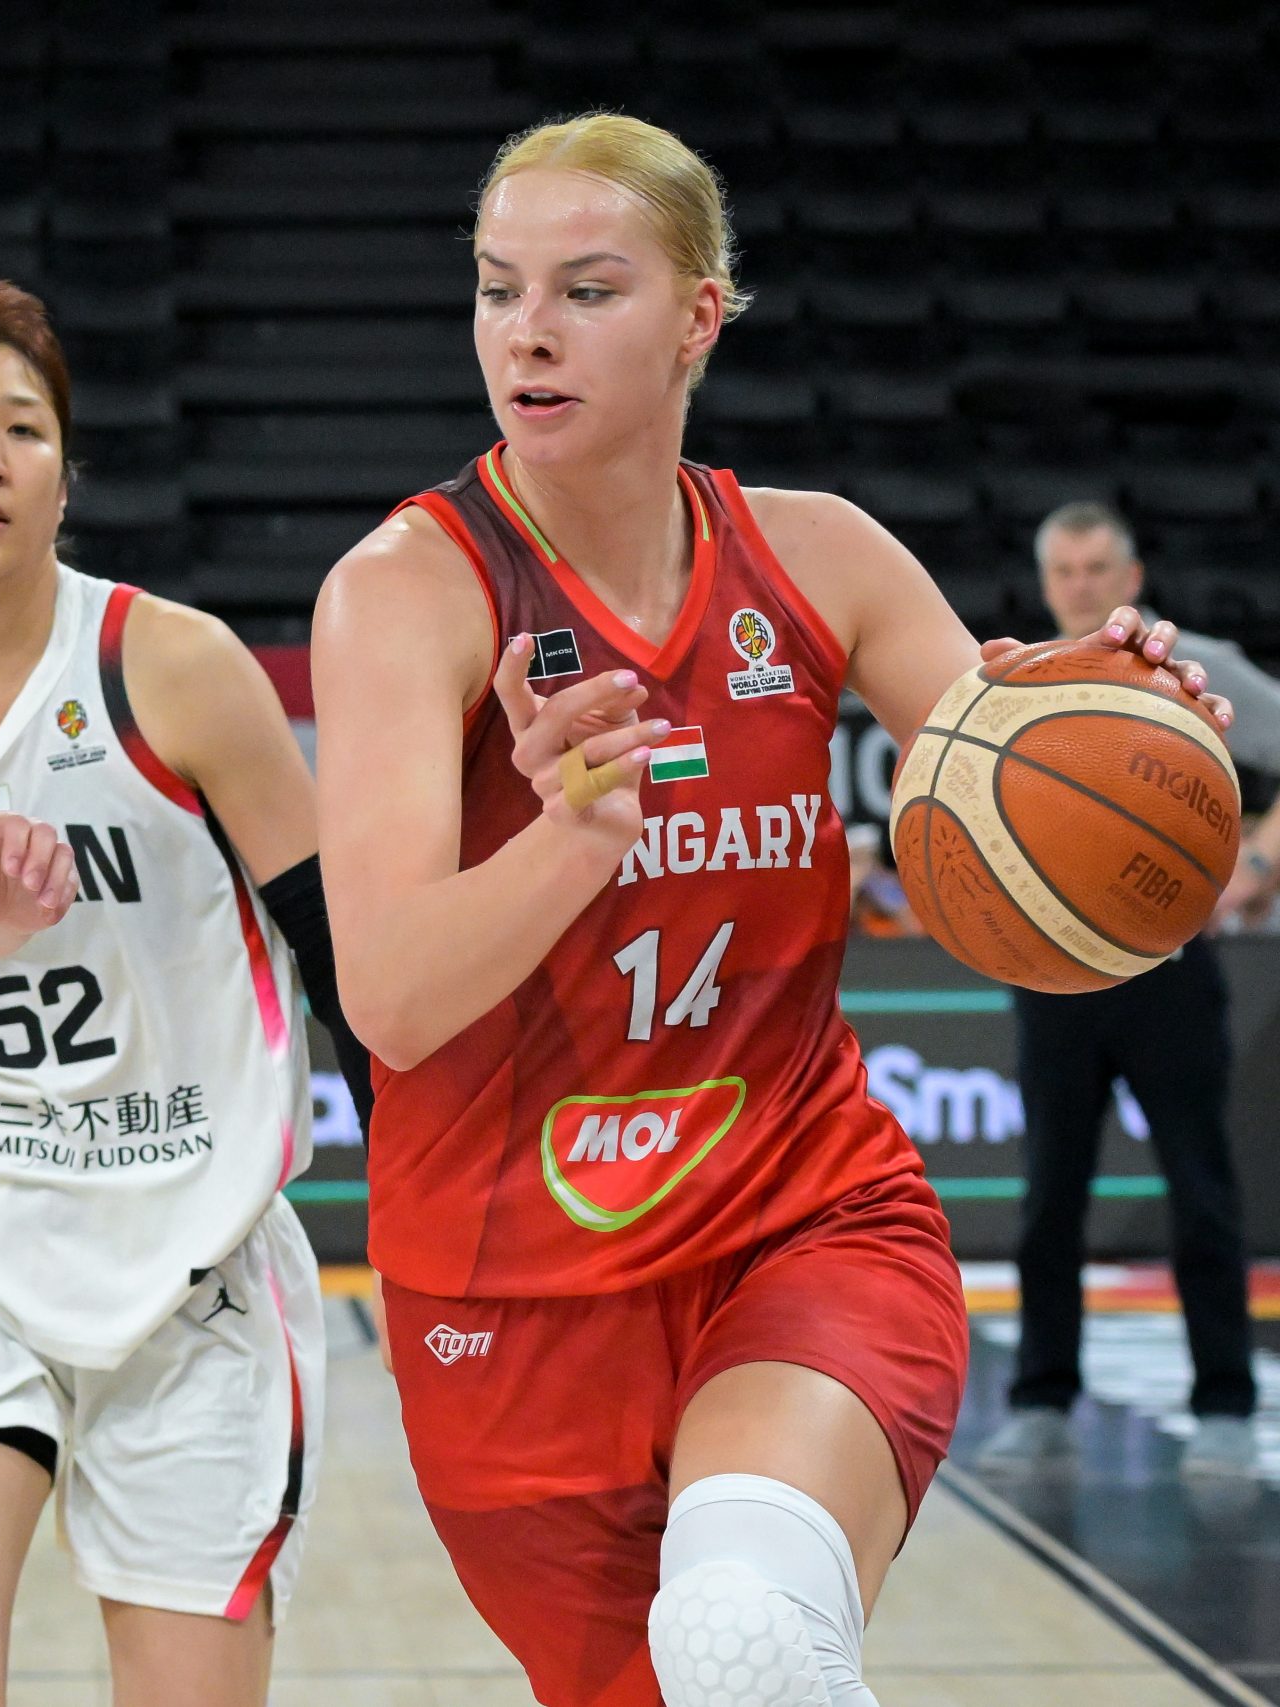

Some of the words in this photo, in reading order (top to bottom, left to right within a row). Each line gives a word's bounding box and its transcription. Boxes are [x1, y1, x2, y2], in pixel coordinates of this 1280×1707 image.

[731, 680, 758, 690] WORLD
[760, 677, 776, 686] CUP
[1128, 751, 1233, 844] molten
[618, 794, 822, 887] NGARY
[1120, 853, 1182, 910] FIBA
[613, 922, 734, 1041] 14
[84, 1131, 213, 1169] FUDOSAN
[566, 1107, 682, 1162] MOL
[437, 1332, 494, 1357] TOTI
